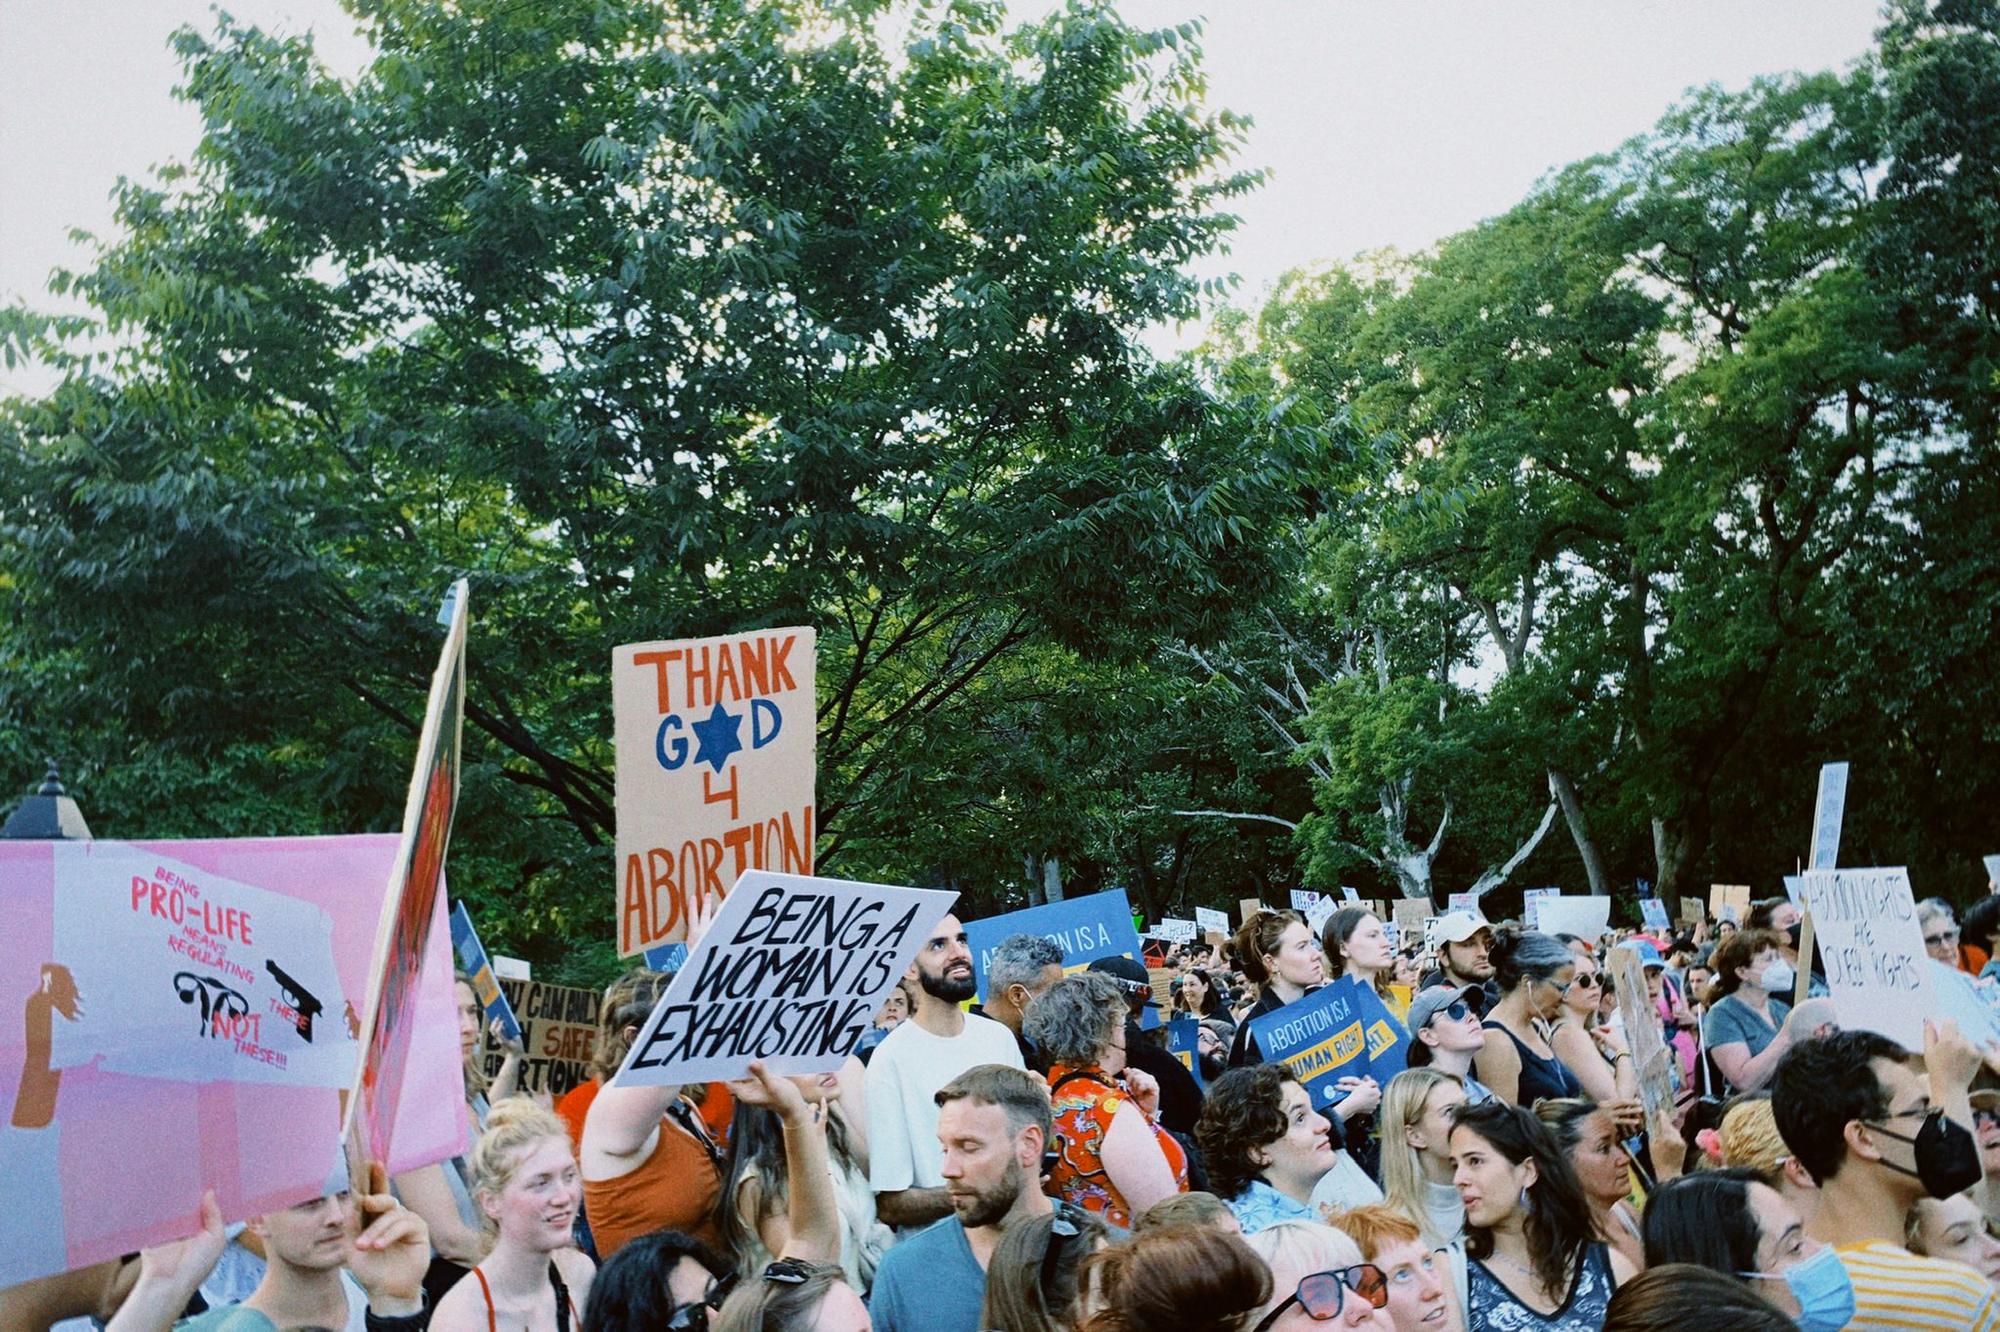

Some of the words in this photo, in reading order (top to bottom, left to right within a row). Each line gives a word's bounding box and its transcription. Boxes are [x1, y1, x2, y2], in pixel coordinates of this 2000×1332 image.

[633, 635, 797, 715] THANK
[703, 765, 739, 820] 4
[155, 866, 199, 899] BEING
[131, 876, 253, 945] PRO-LIFE
[730, 887, 884, 950] BEING
[875, 902, 921, 948] A
[1074, 926, 1095, 951] IS
[1099, 922, 1112, 947] A
[167, 934, 255, 985] REGULATING
[689, 945, 859, 1002] WOMAN
[847, 950, 897, 997] IS
[213, 1010, 261, 1042] NOT
[270, 997, 310, 1031] THESE
[628, 999, 870, 1071] EXHAUSTING
[1267, 1006, 1333, 1055] ABORTION
[1330, 1000, 1344, 1023] IS
[1341, 996, 1351, 1018] A
[542, 1025, 596, 1061] SAFE
